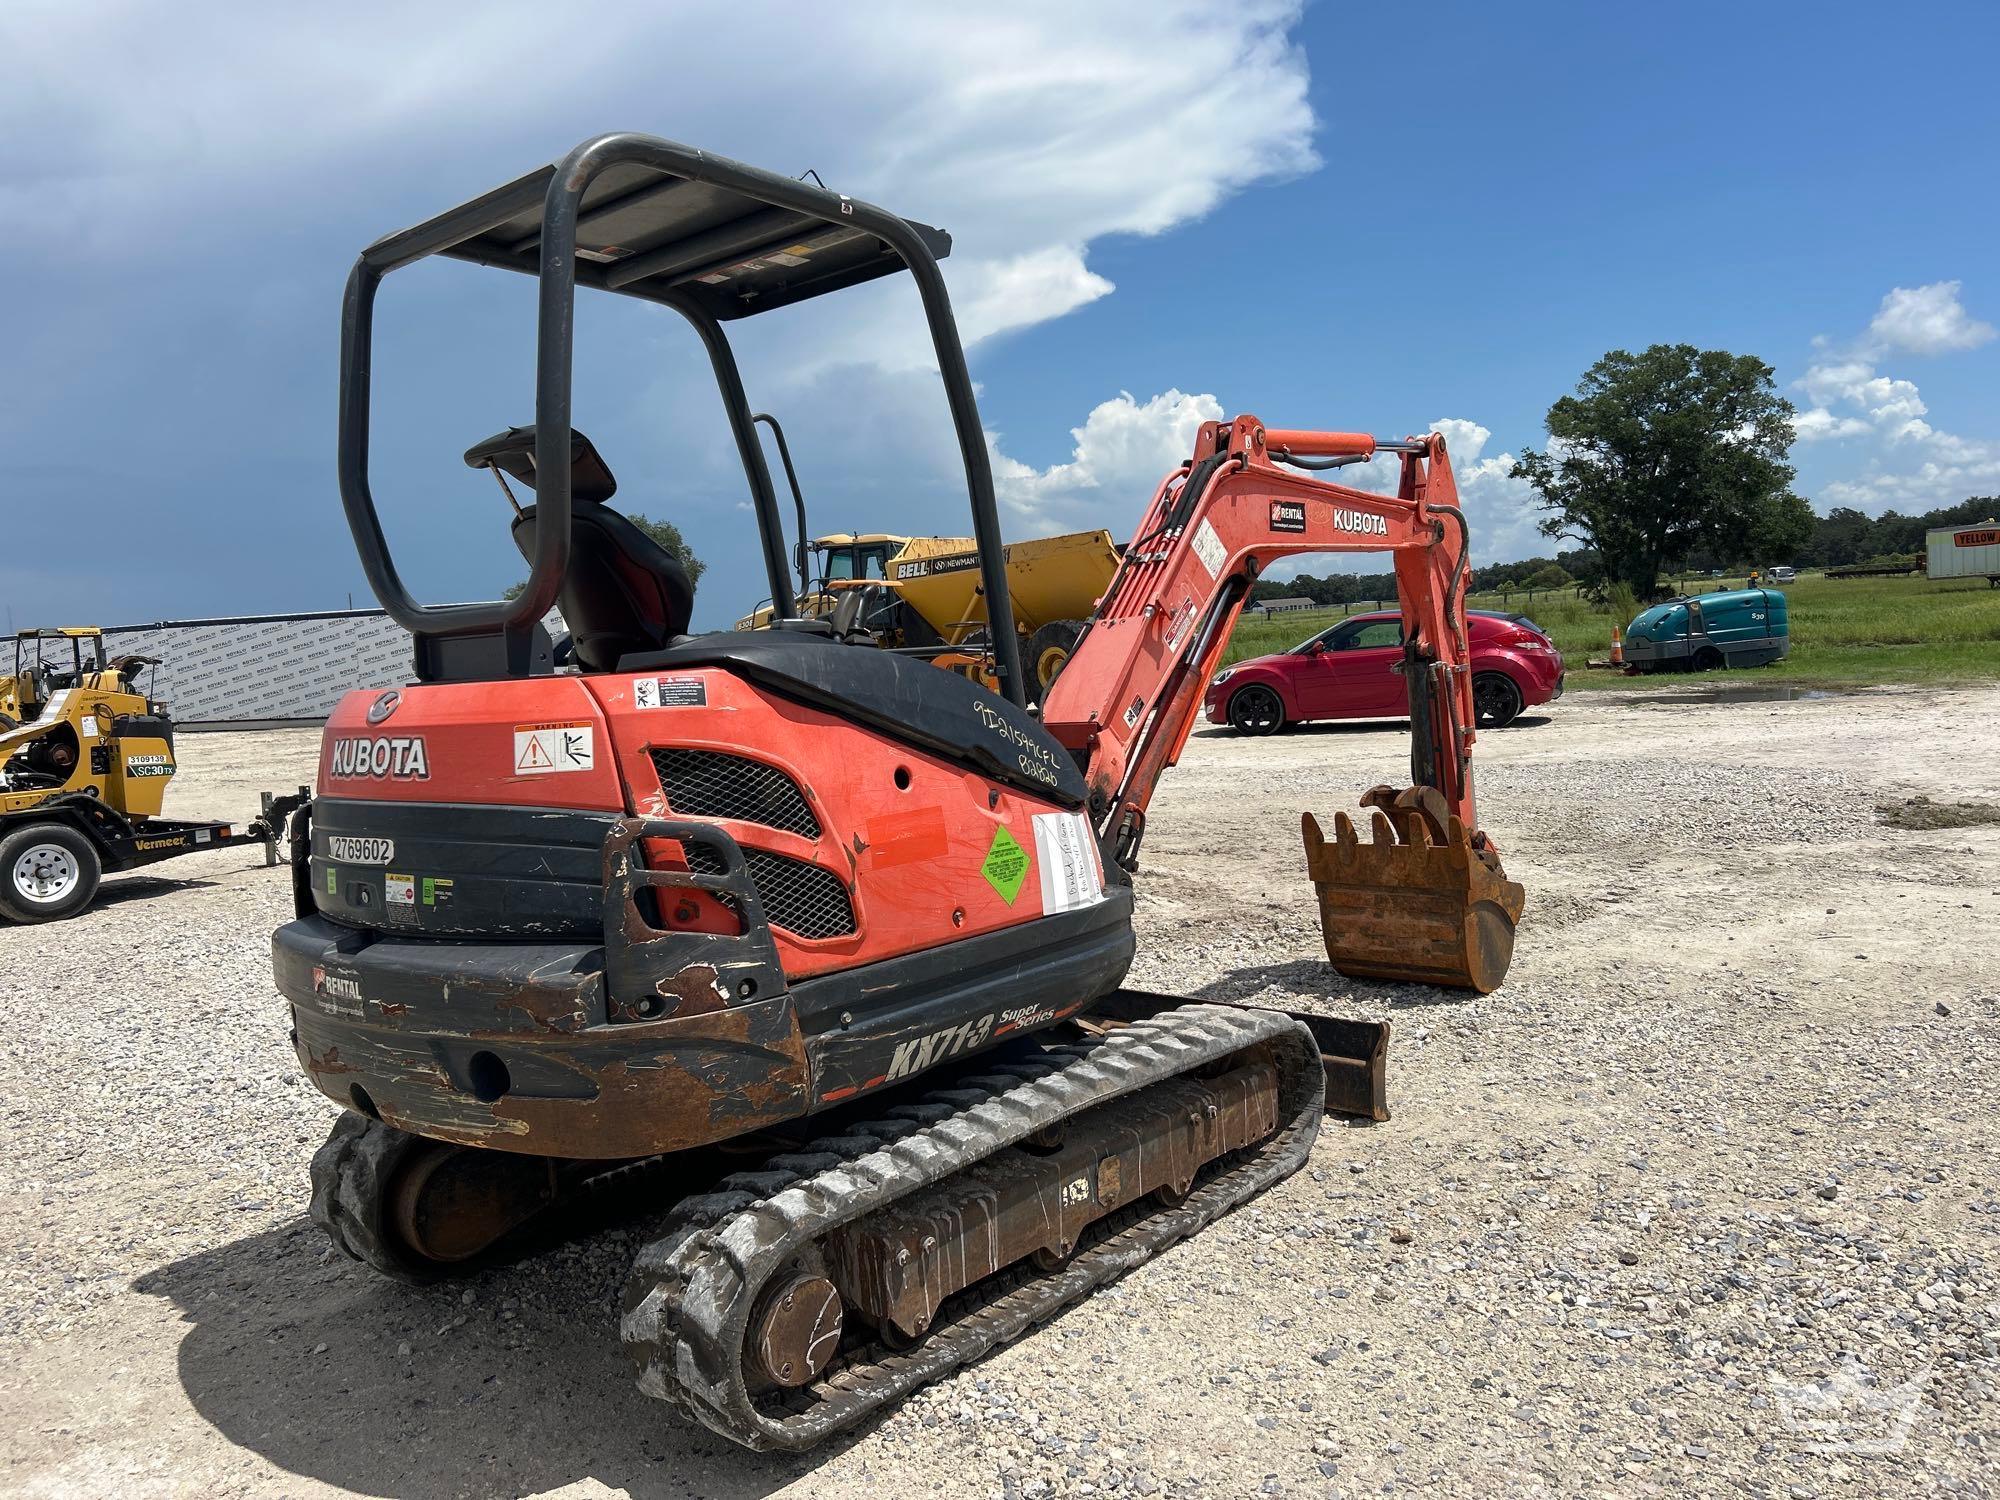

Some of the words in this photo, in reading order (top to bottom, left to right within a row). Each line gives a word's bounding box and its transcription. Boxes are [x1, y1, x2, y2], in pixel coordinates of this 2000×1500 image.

[1281, 507, 1303, 520] RENTAL
[1334, 508, 1388, 535] KUBOTA
[1960, 532, 1996, 544] YELLOW
[898, 562, 928, 579] BELL
[332, 738, 427, 775] KUBOTA
[135, 836, 185, 850] Vermeer
[335, 838, 390, 860] 2769602
[326, 976, 362, 1000] RENTAL
[1014, 1009, 1054, 1030] Series
[884, 1014, 995, 1082] KX71-3
[1000, 1002, 1040, 1023] Super
